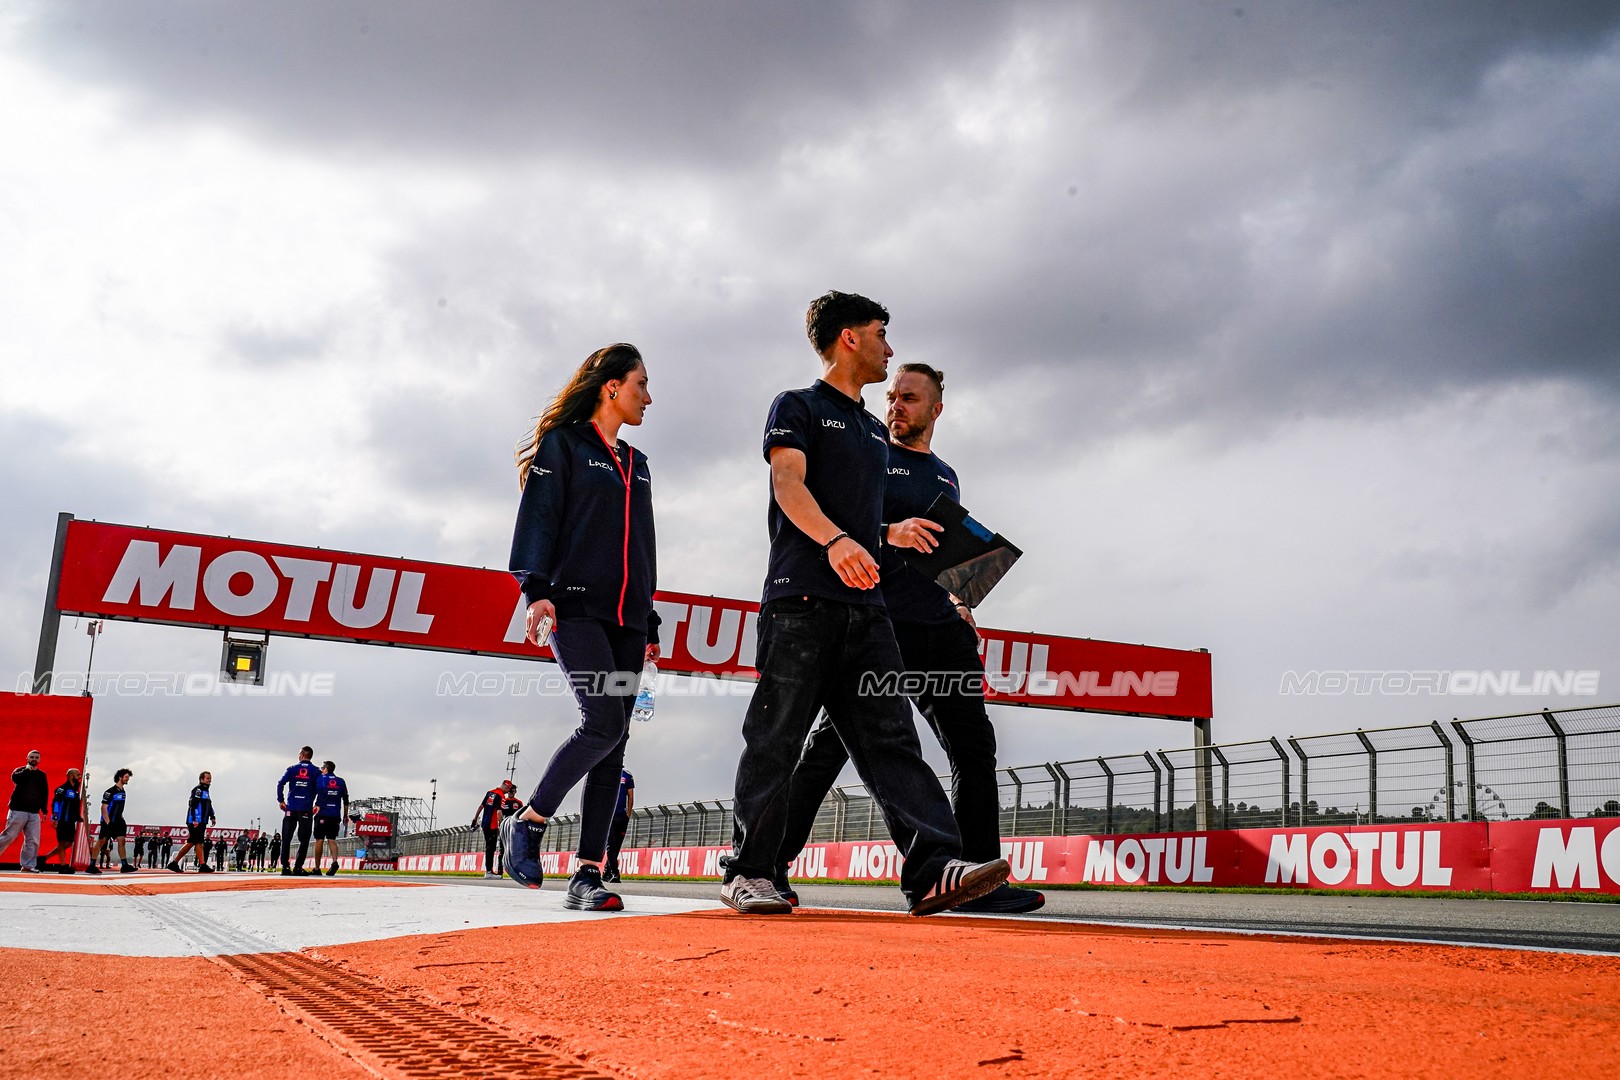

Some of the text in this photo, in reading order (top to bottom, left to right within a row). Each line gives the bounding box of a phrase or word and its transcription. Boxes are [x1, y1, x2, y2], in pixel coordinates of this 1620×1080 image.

[821, 418, 846, 429] LAZU
[588, 459, 614, 471] LAZU
[886, 467, 910, 476] LAZU
[101, 539, 435, 634] MOTUL
[359, 824, 389, 833] MOTUL
[363, 862, 395, 871] MOTUL
[540, 853, 560, 874] OTUL
[650, 849, 691, 876] MOTUL
[1083, 836, 1214, 884] MOTUL
[1264, 830, 1453, 887] MOTUL
